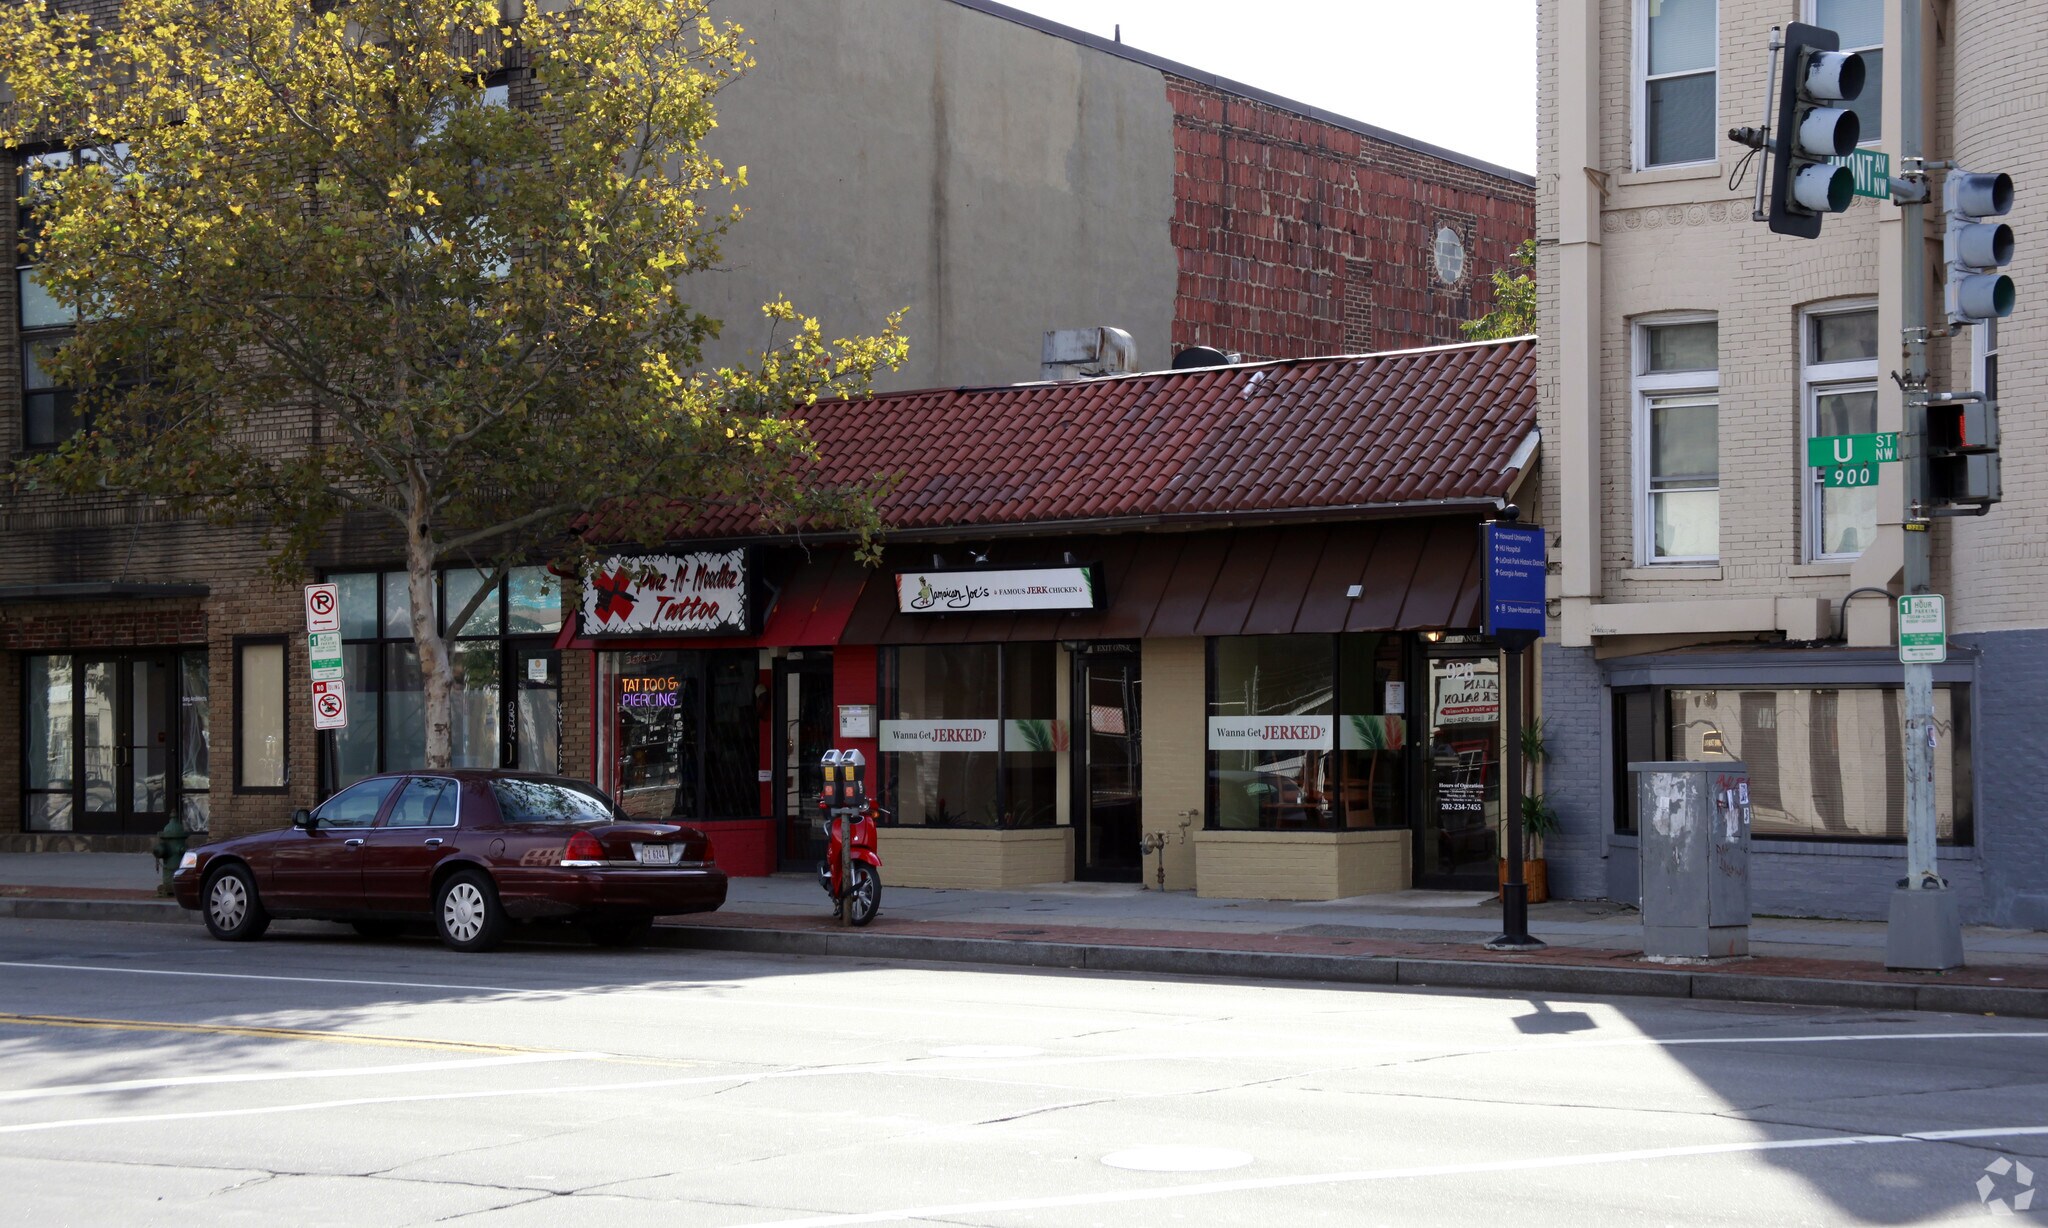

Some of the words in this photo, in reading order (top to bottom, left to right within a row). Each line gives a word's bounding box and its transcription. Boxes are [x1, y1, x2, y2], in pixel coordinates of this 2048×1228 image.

[1827, 153, 1873, 192] ONT
[1875, 154, 1886, 173] AV
[1874, 177, 1887, 197] NW
[1834, 438, 1853, 463] U
[1875, 434, 1893, 448] ST
[1875, 448, 1893, 461] NW
[1834, 468, 1870, 485] 900
[1514, 534, 1532, 543] University
[1506, 546, 1521, 554] Hospital
[911, 585, 964, 609] Jamaican
[947, 585, 989, 608] Joe's
[999, 587, 1026, 595] FAMOUS
[1026, 586, 1049, 595] JERK
[1048, 586, 1078, 594] CHICKEN
[652, 596, 720, 624] Tattoo
[1902, 600, 1909, 614] 1
[311, 636, 317, 646] 1
[1096, 644, 1112, 652] EXIT
[1446, 662, 1474, 680] 928
[316, 684, 324, 692] NO
[668, 676, 679, 690] &
[622, 692, 678, 706] PIERCING
[892, 730, 918, 740] Wanna
[919, 730, 931, 740] Get
[1217, 728, 1246, 737] Wanna
[1247, 728, 1262, 737] Get
[1441, 803, 1482, 811] 202-234-7455
